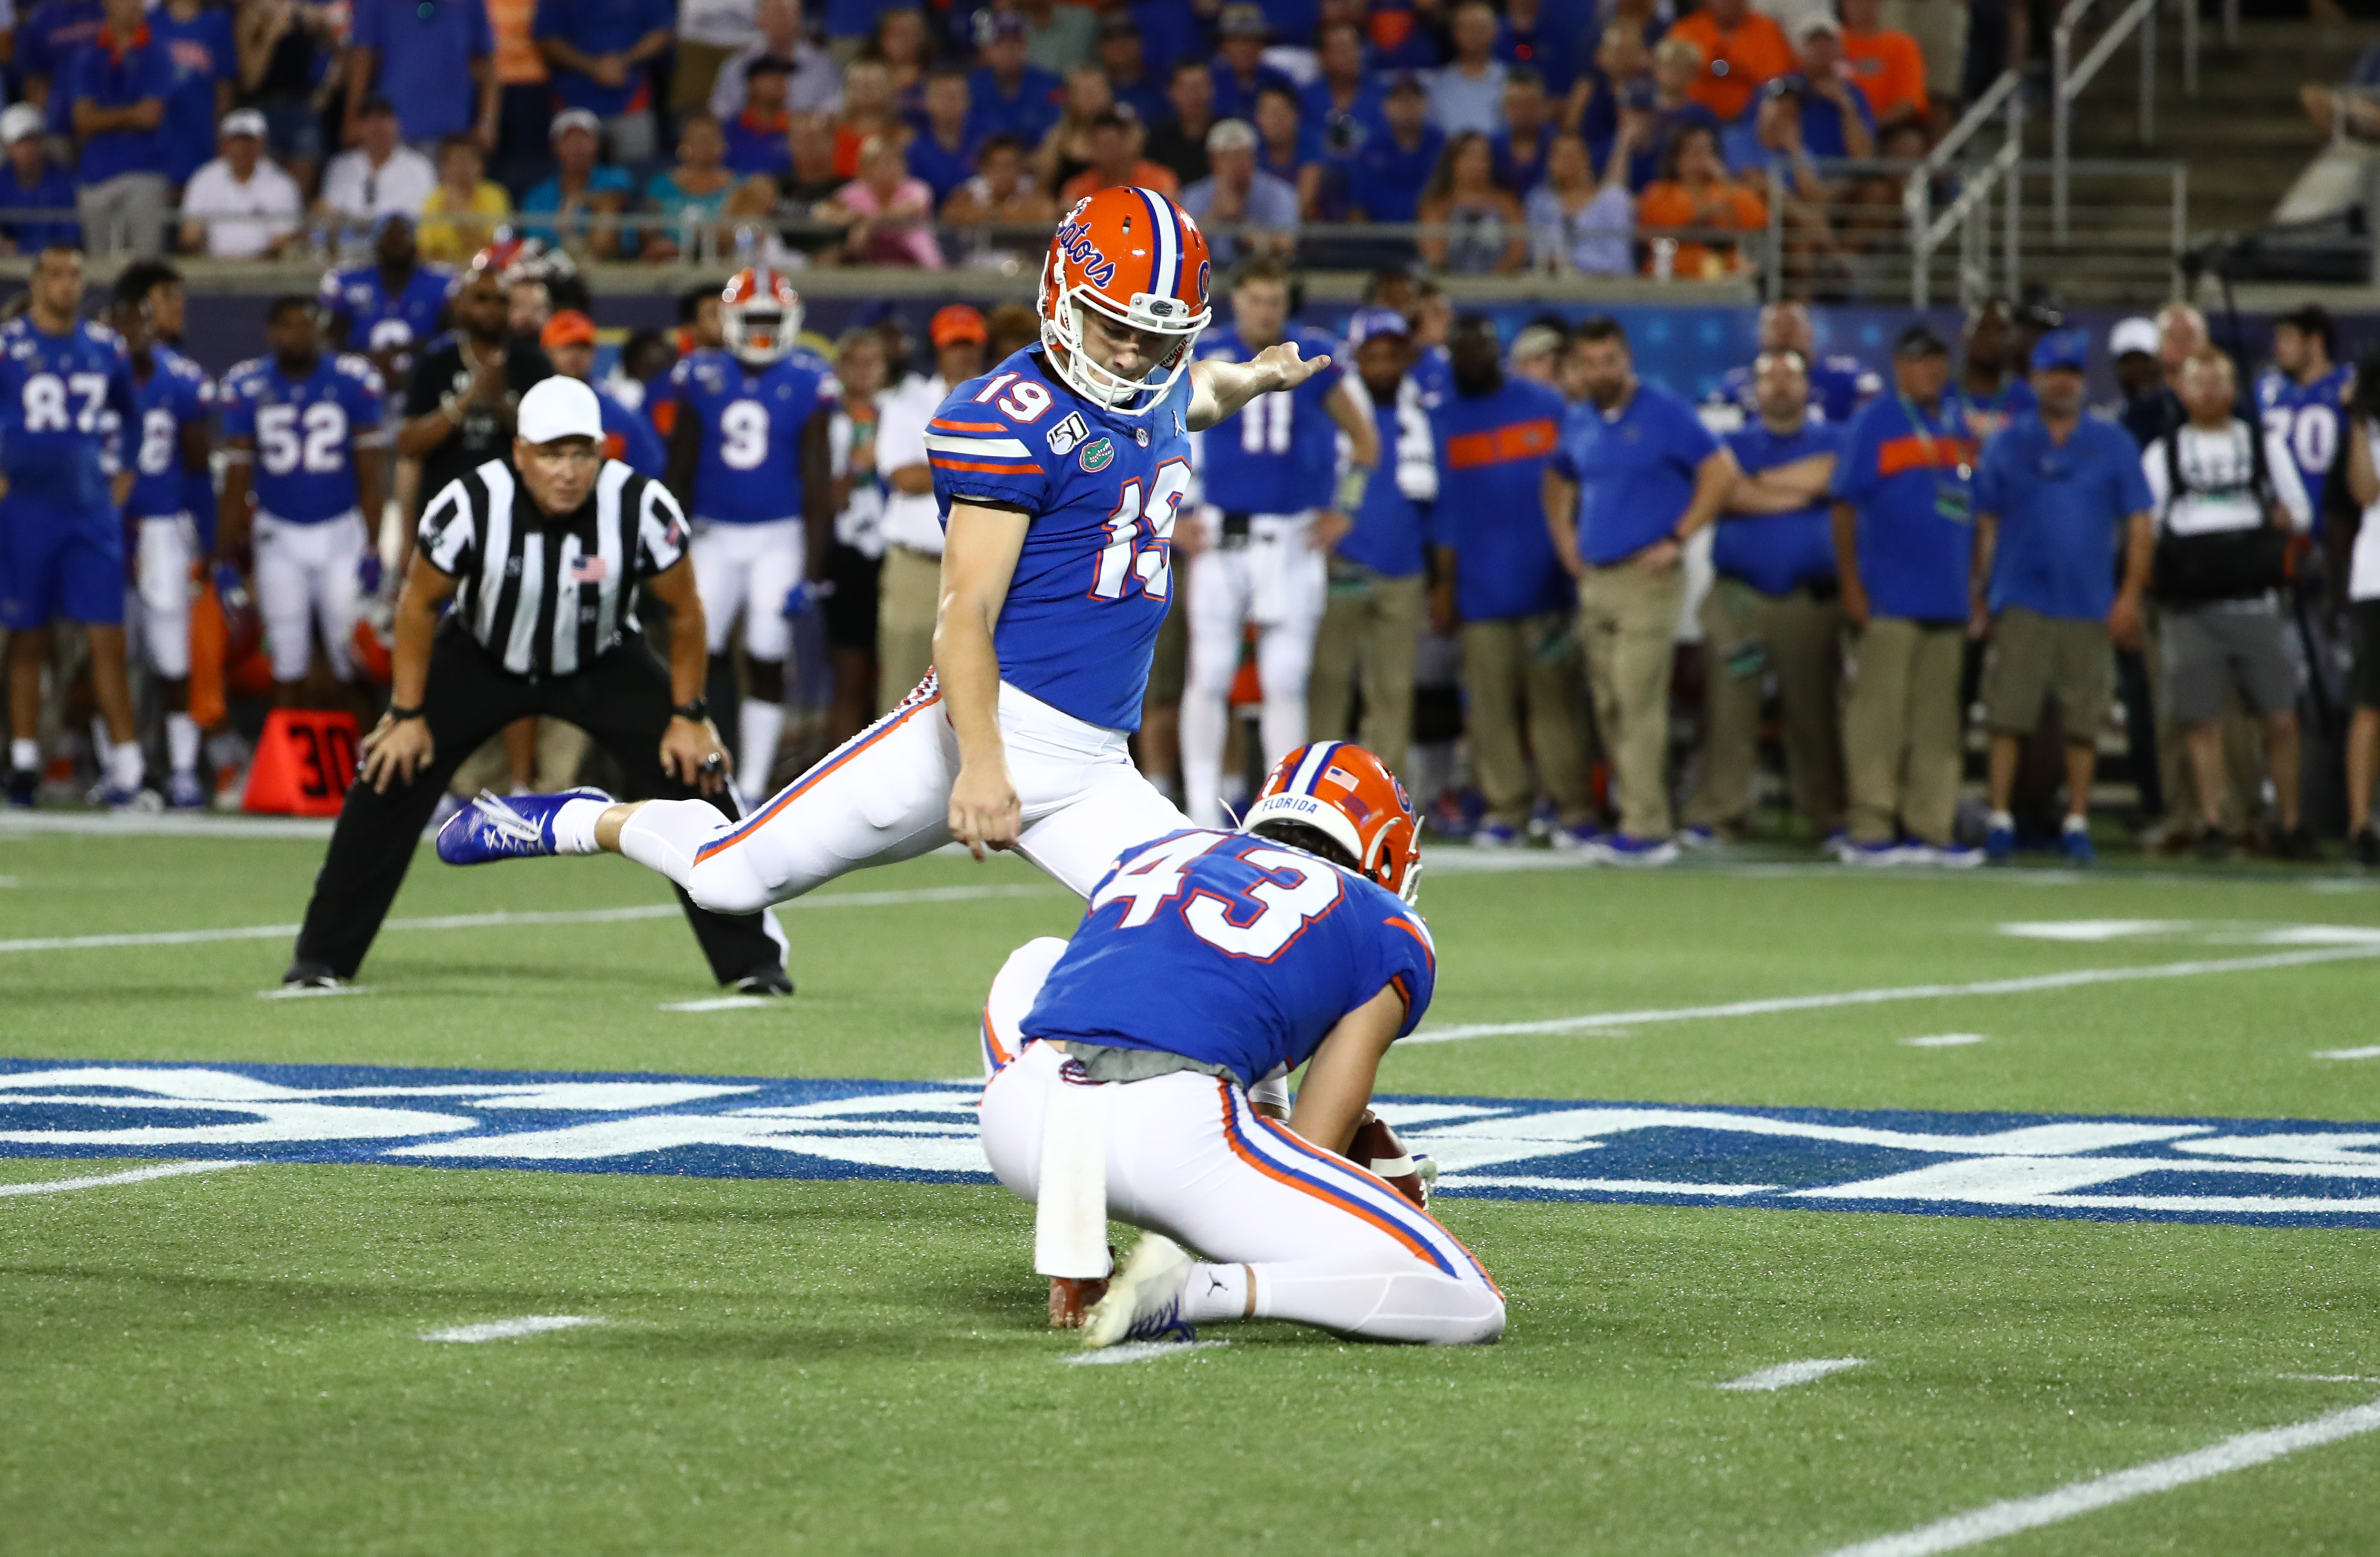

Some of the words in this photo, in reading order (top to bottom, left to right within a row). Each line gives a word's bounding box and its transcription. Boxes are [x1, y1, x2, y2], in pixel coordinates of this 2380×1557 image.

[22, 372, 109, 433] 87
[971, 371, 1055, 424] 19
[254, 401, 348, 475] 52
[720, 399, 770, 470] 9
[1088, 455, 1192, 602] 19
[289, 724, 357, 797] 30
[1263, 798, 1318, 814] FLORIDA
[1089, 830, 1344, 964] 43
